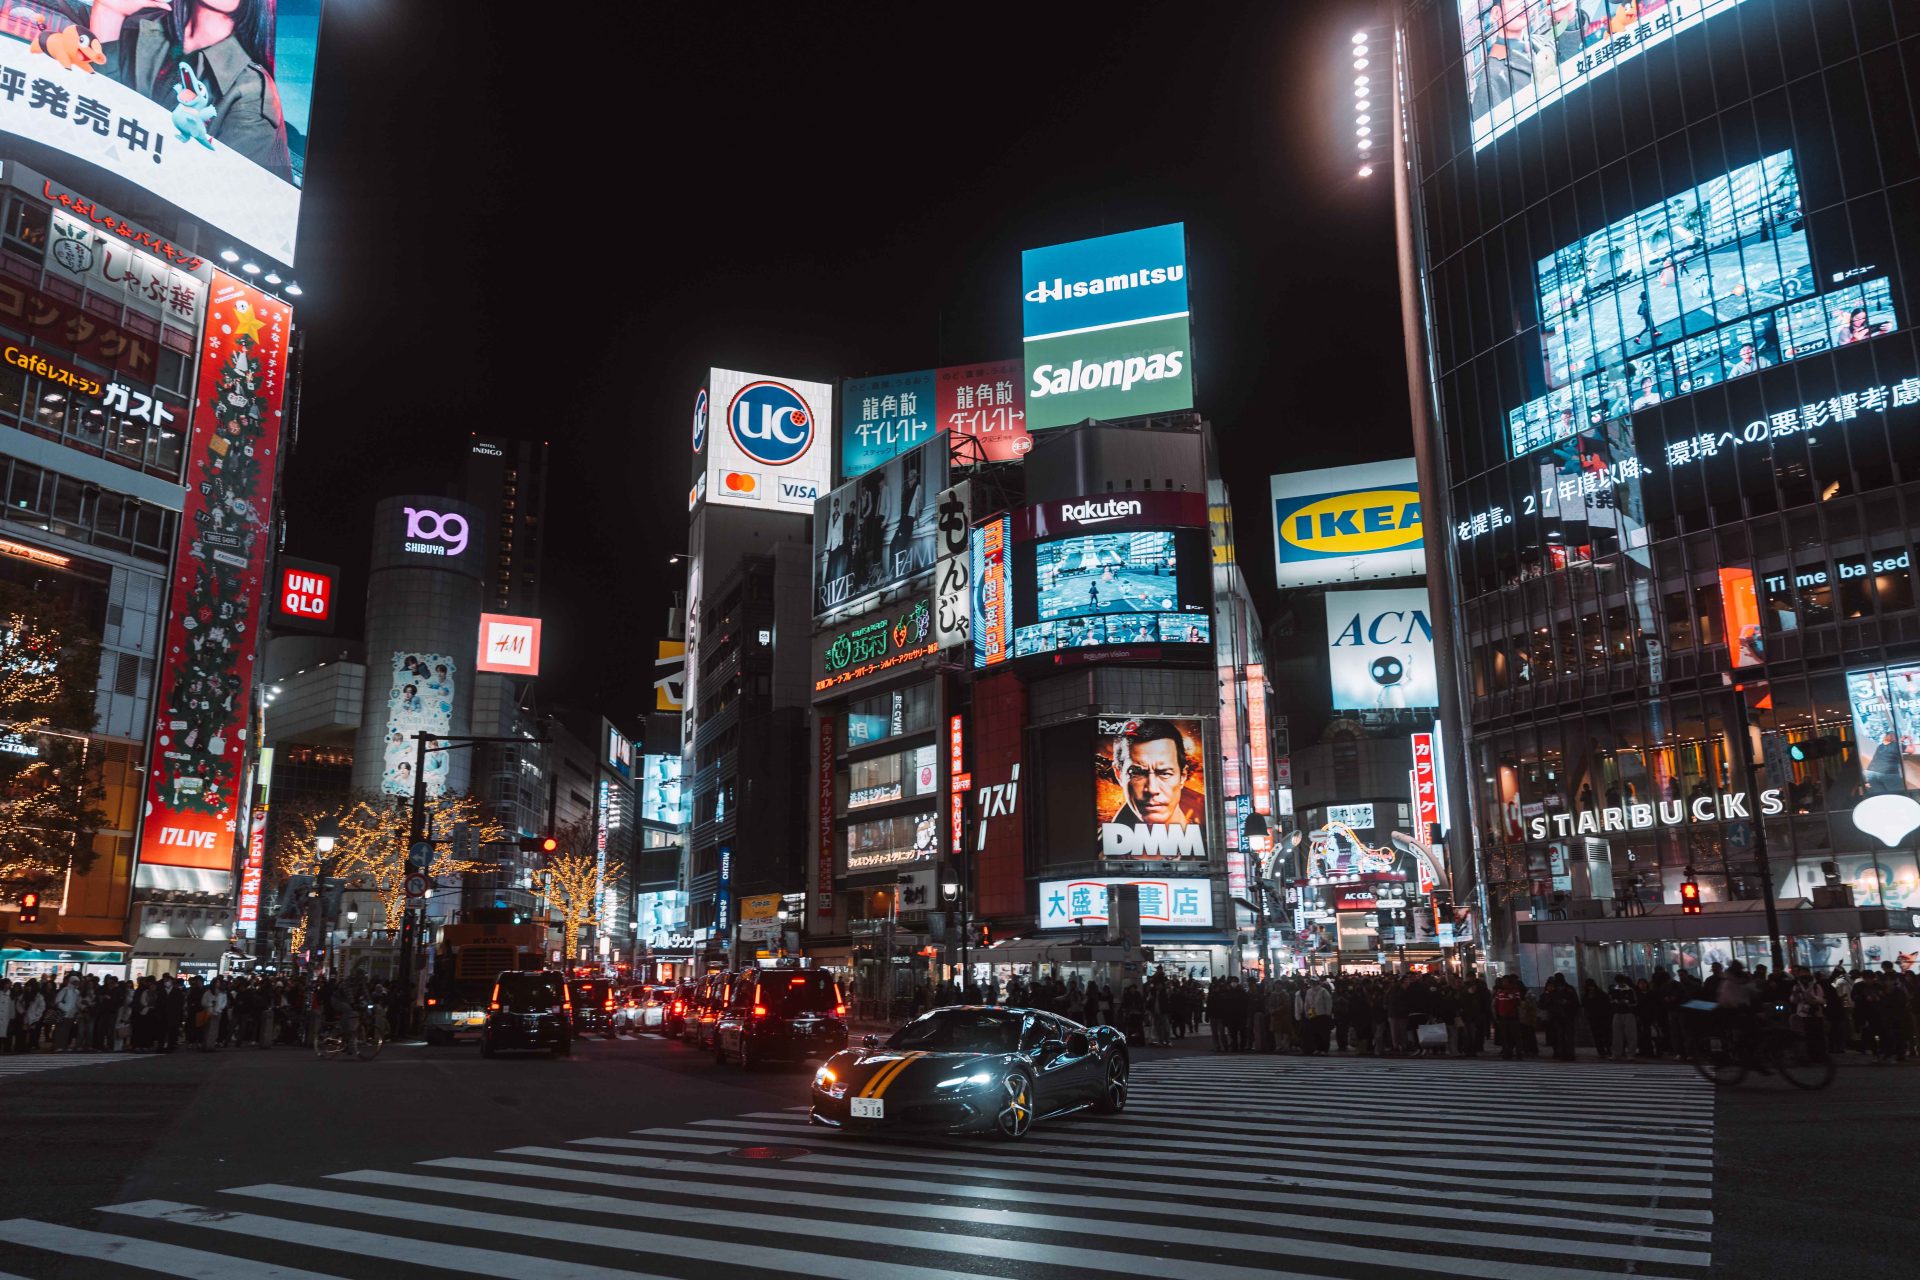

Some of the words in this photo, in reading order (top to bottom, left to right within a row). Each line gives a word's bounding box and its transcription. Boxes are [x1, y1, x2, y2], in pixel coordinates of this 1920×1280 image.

[1576, 5, 1684, 75] 好評発売中!
[43, 180, 205, 271] しゃぶしゃぶバイキング
[103, 250, 196, 316] しゃぶ葉
[1025, 265, 1183, 303] Hisamitsu
[4, 346, 100, 396] Caféレストラン
[103, 382, 174, 426] ガスト
[1030, 350, 1183, 398] Salonpas
[862, 391, 918, 421] 龍角散
[957, 380, 1013, 410] 龍角散
[740, 401, 807, 444] UC
[854, 418, 928, 447] ダイレクト
[949, 407, 1024, 436] ダイレクト
[472, 446, 503, 457] INDIGO
[783, 484, 817, 500] VISA
[1062, 499, 1141, 522] Rakuten
[1296, 502, 1423, 541] IKEA
[1458, 506, 1512, 542] を提言。
[404, 507, 469, 556] 109
[405, 543, 444, 555] SHIBUYA
[938, 491, 970, 640] もんじゃ
[289, 574, 323, 595] UNI
[286, 593, 325, 614] QLO
[495, 634, 526, 655] H&M
[1416, 744, 1436, 813] カラオケ
[1532, 790, 1783, 840] STARBUCKS
[159, 827, 217, 849] 17LIVE
[1102, 823, 1205, 856] DMM
